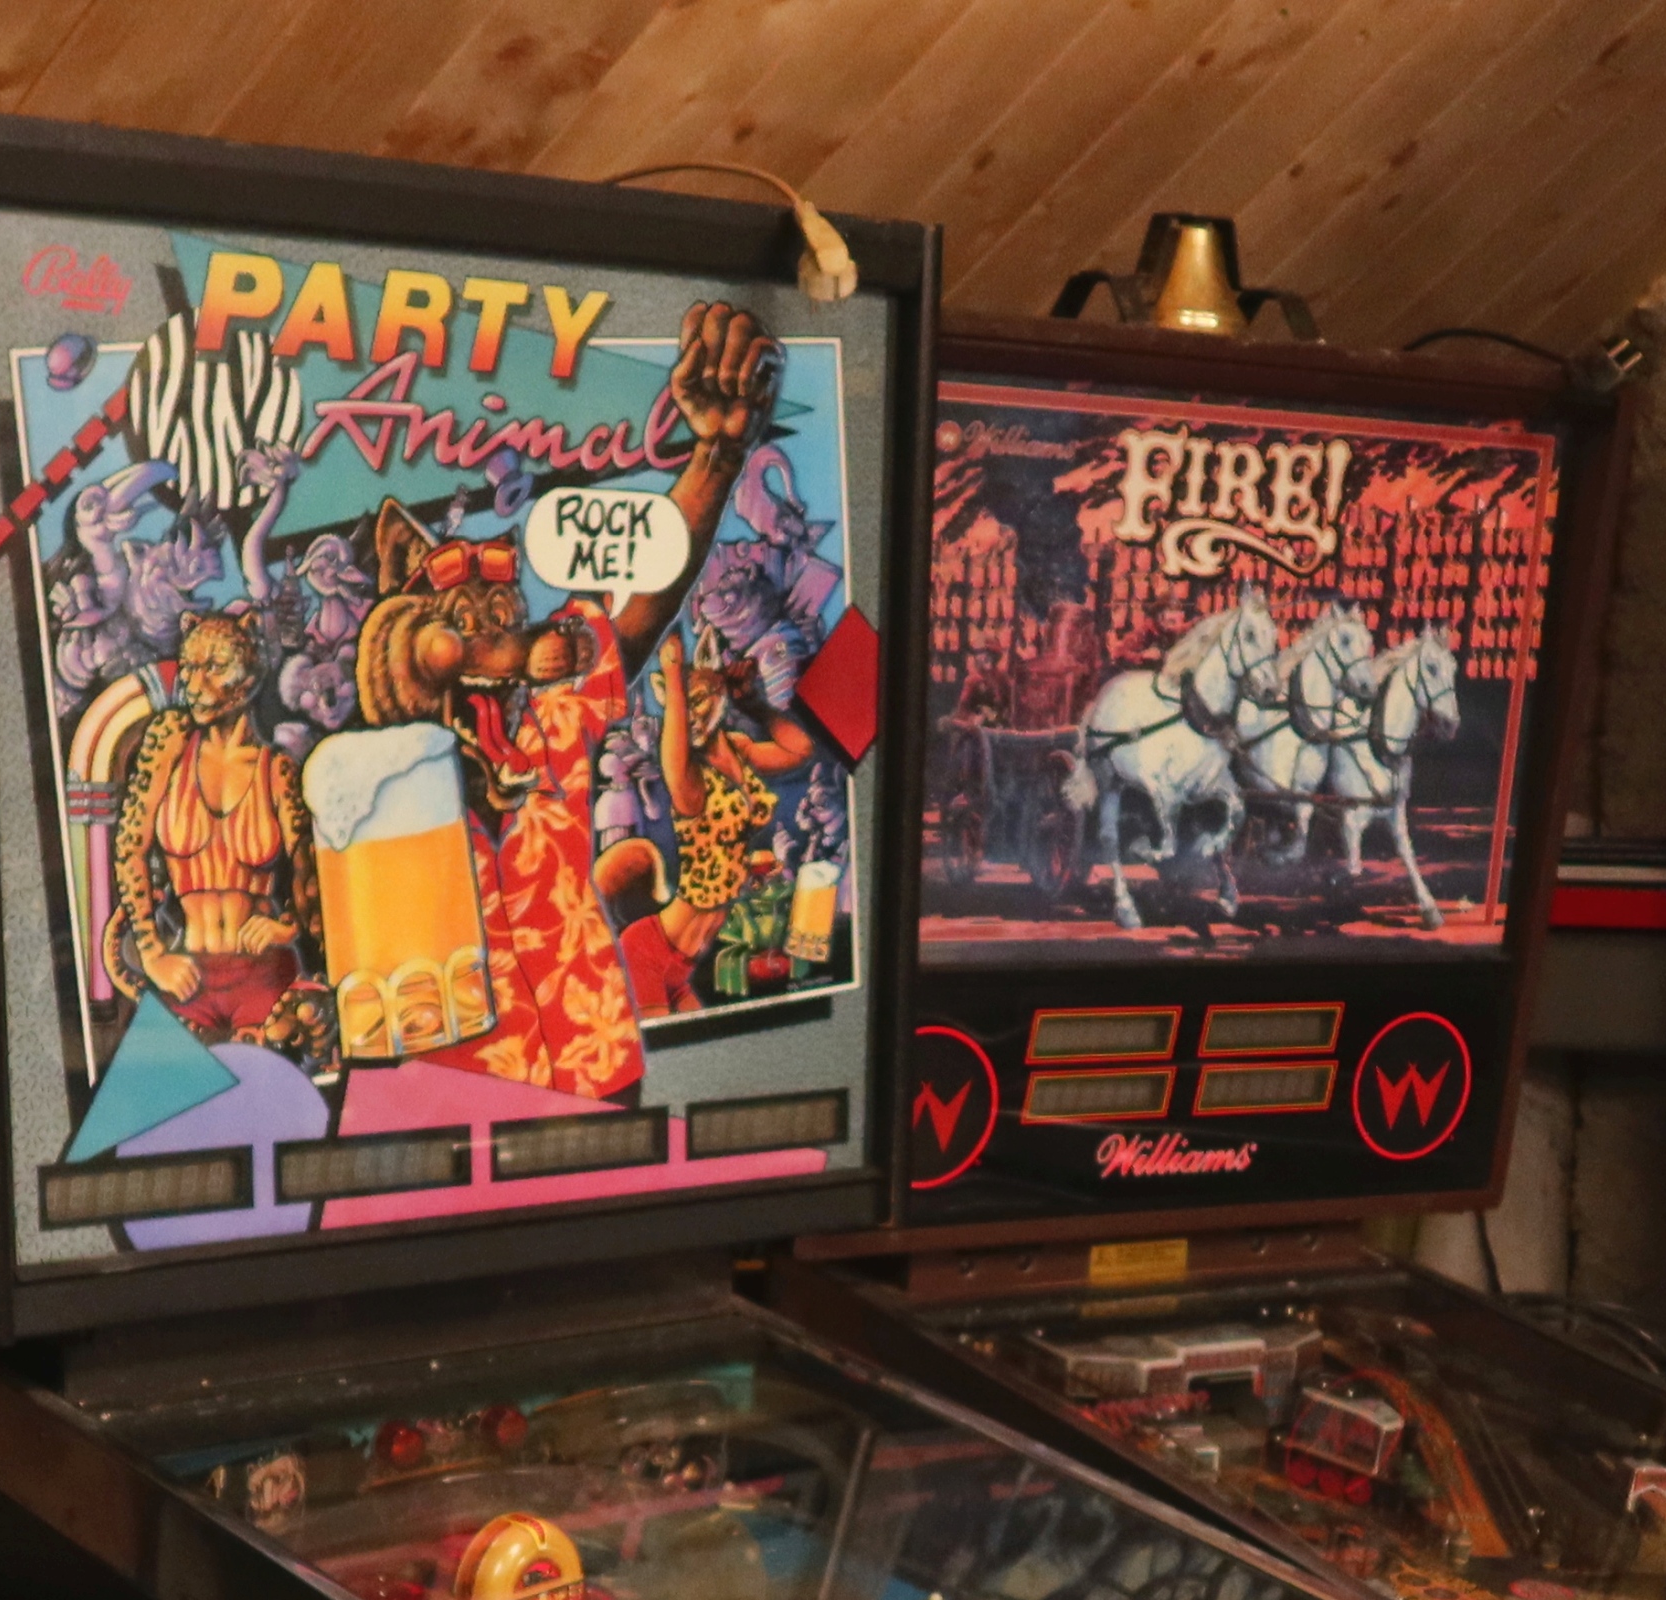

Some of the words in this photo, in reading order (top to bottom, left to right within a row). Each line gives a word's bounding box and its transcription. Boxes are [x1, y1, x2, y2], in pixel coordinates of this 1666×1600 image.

[195, 251, 609, 378] PARTY
[304, 352, 691, 470] Animal
[556, 496, 652, 541] ROCK
[1113, 425, 1352, 562] FIRE!
[572, 538, 636, 584] ME!
[1097, 1132, 1257, 1180] Williams
